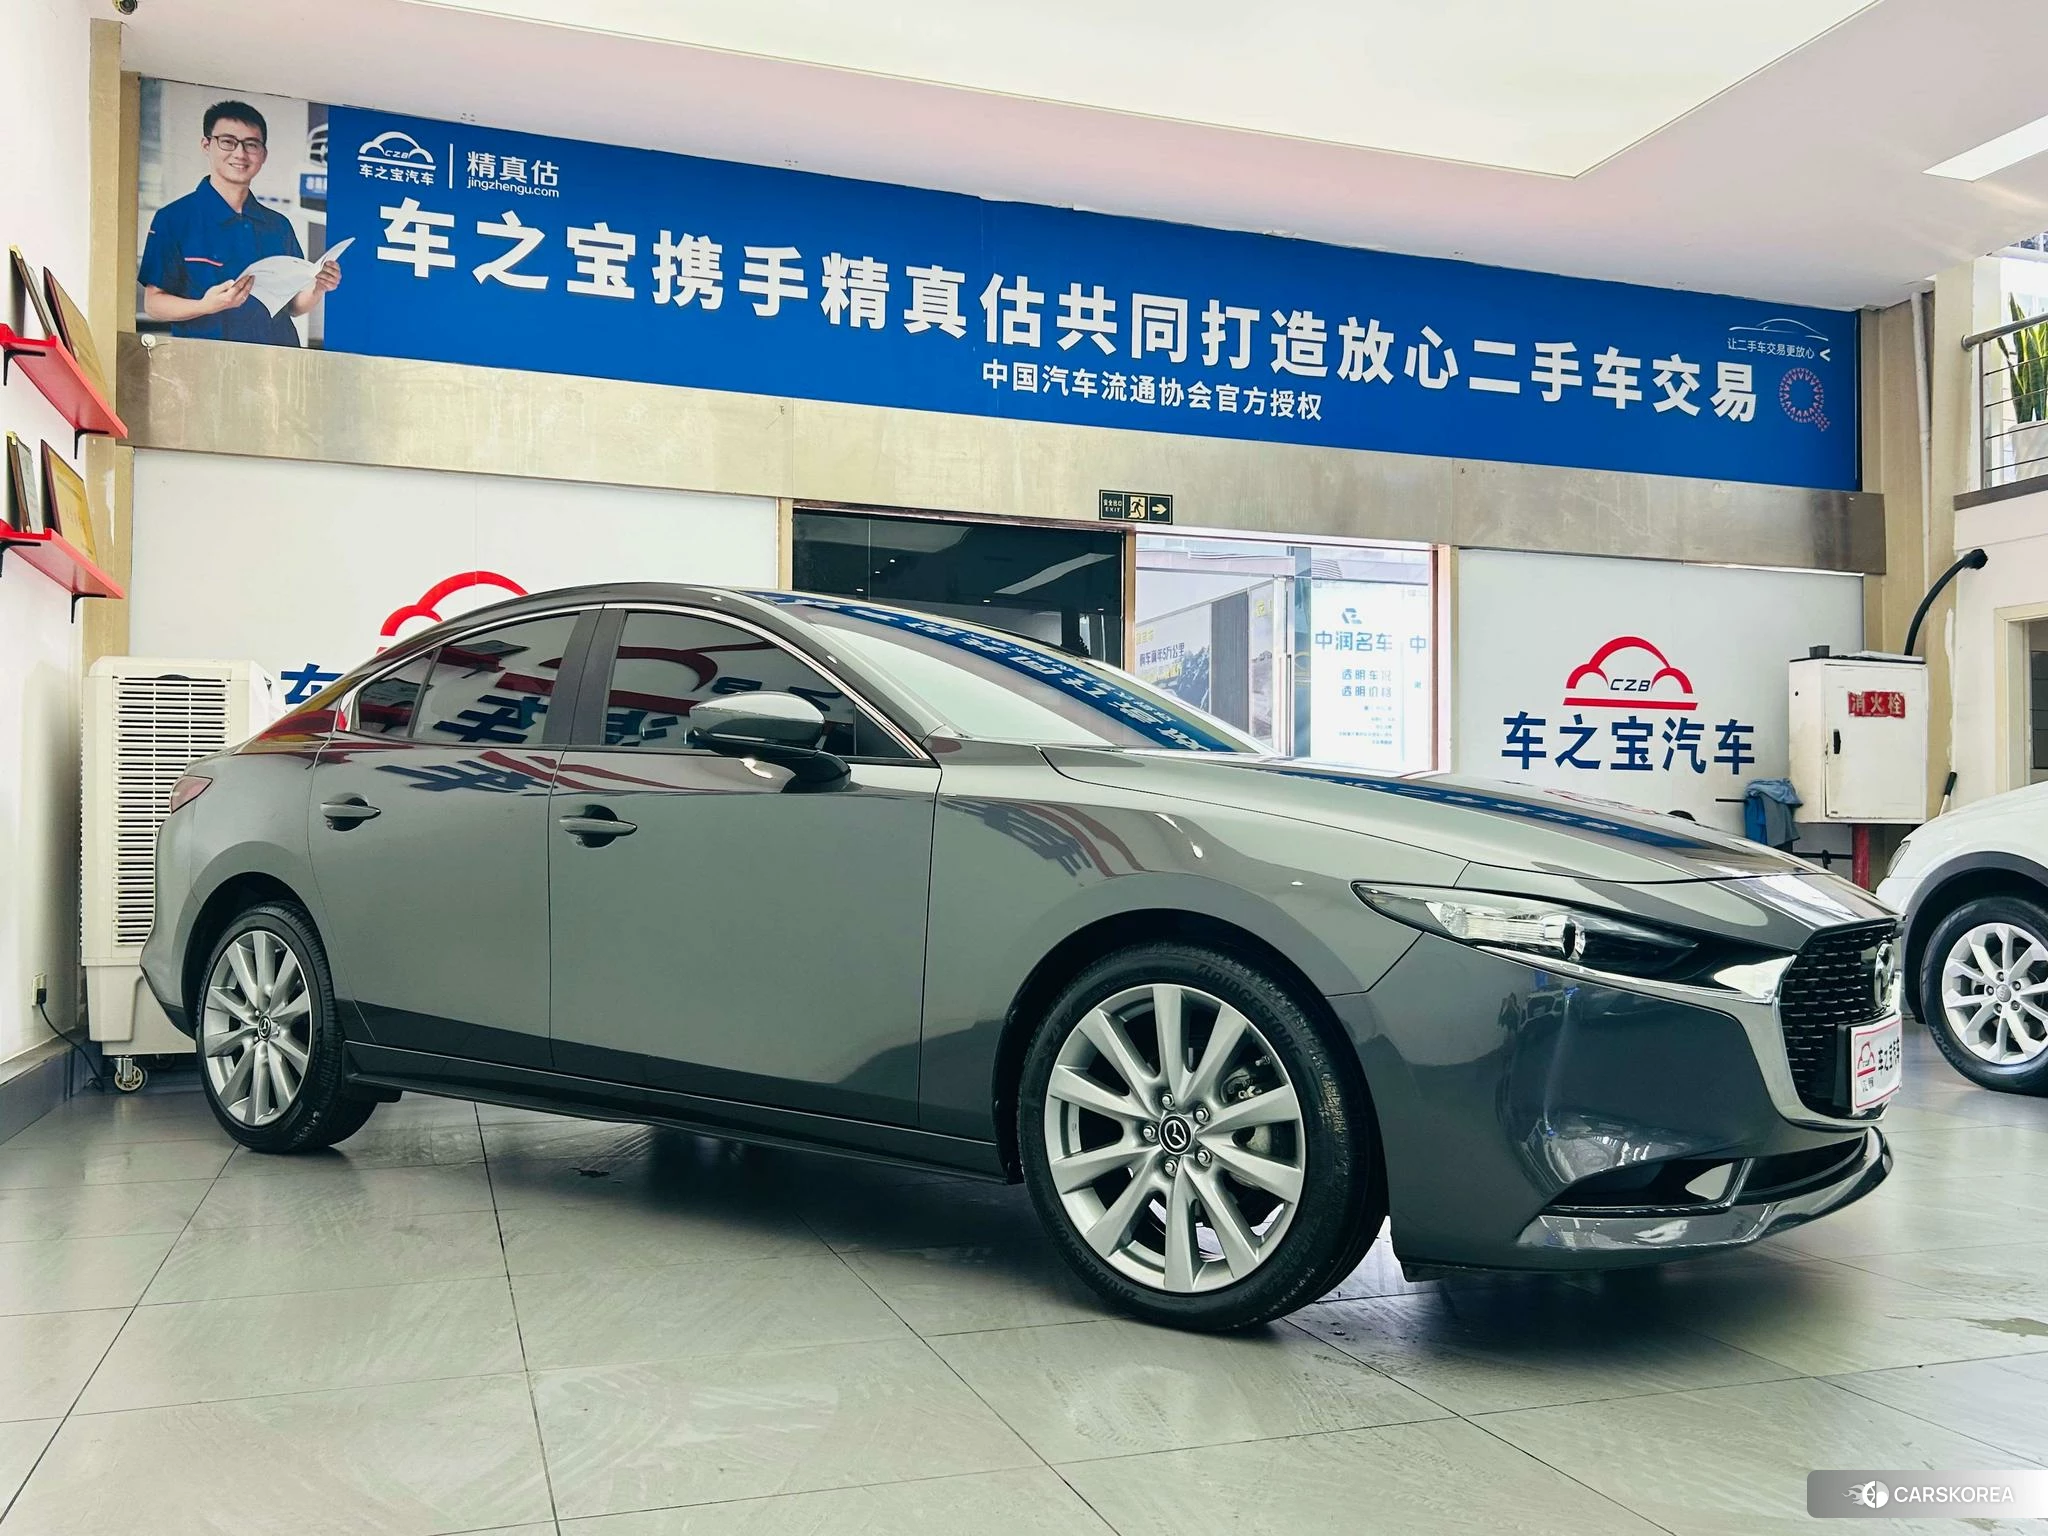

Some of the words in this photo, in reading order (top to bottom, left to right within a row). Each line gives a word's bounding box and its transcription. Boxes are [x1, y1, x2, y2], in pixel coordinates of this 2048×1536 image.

[384, 149, 409, 159] CZB
[358, 163, 435, 186] 车之宝汽车
[467, 151, 560, 186] 精真估
[467, 177, 560, 198] jingzhengu.com
[377, 196, 1757, 423] 车之宝携手精真估共同打造放心二手车交易
[1727, 337, 1815, 360] 让二手车交易更放心
[982, 358, 1323, 422] 中国汽车流通协会官方授权
[1315, 630, 1393, 652] 中润名车
[1610, 678, 1651, 692] CZB
[1851, 692, 1902, 715] 消火栓
[1501, 711, 1755, 775] 车之宝汽车
[1196, 963, 1303, 1057] BRIDGESTONE
